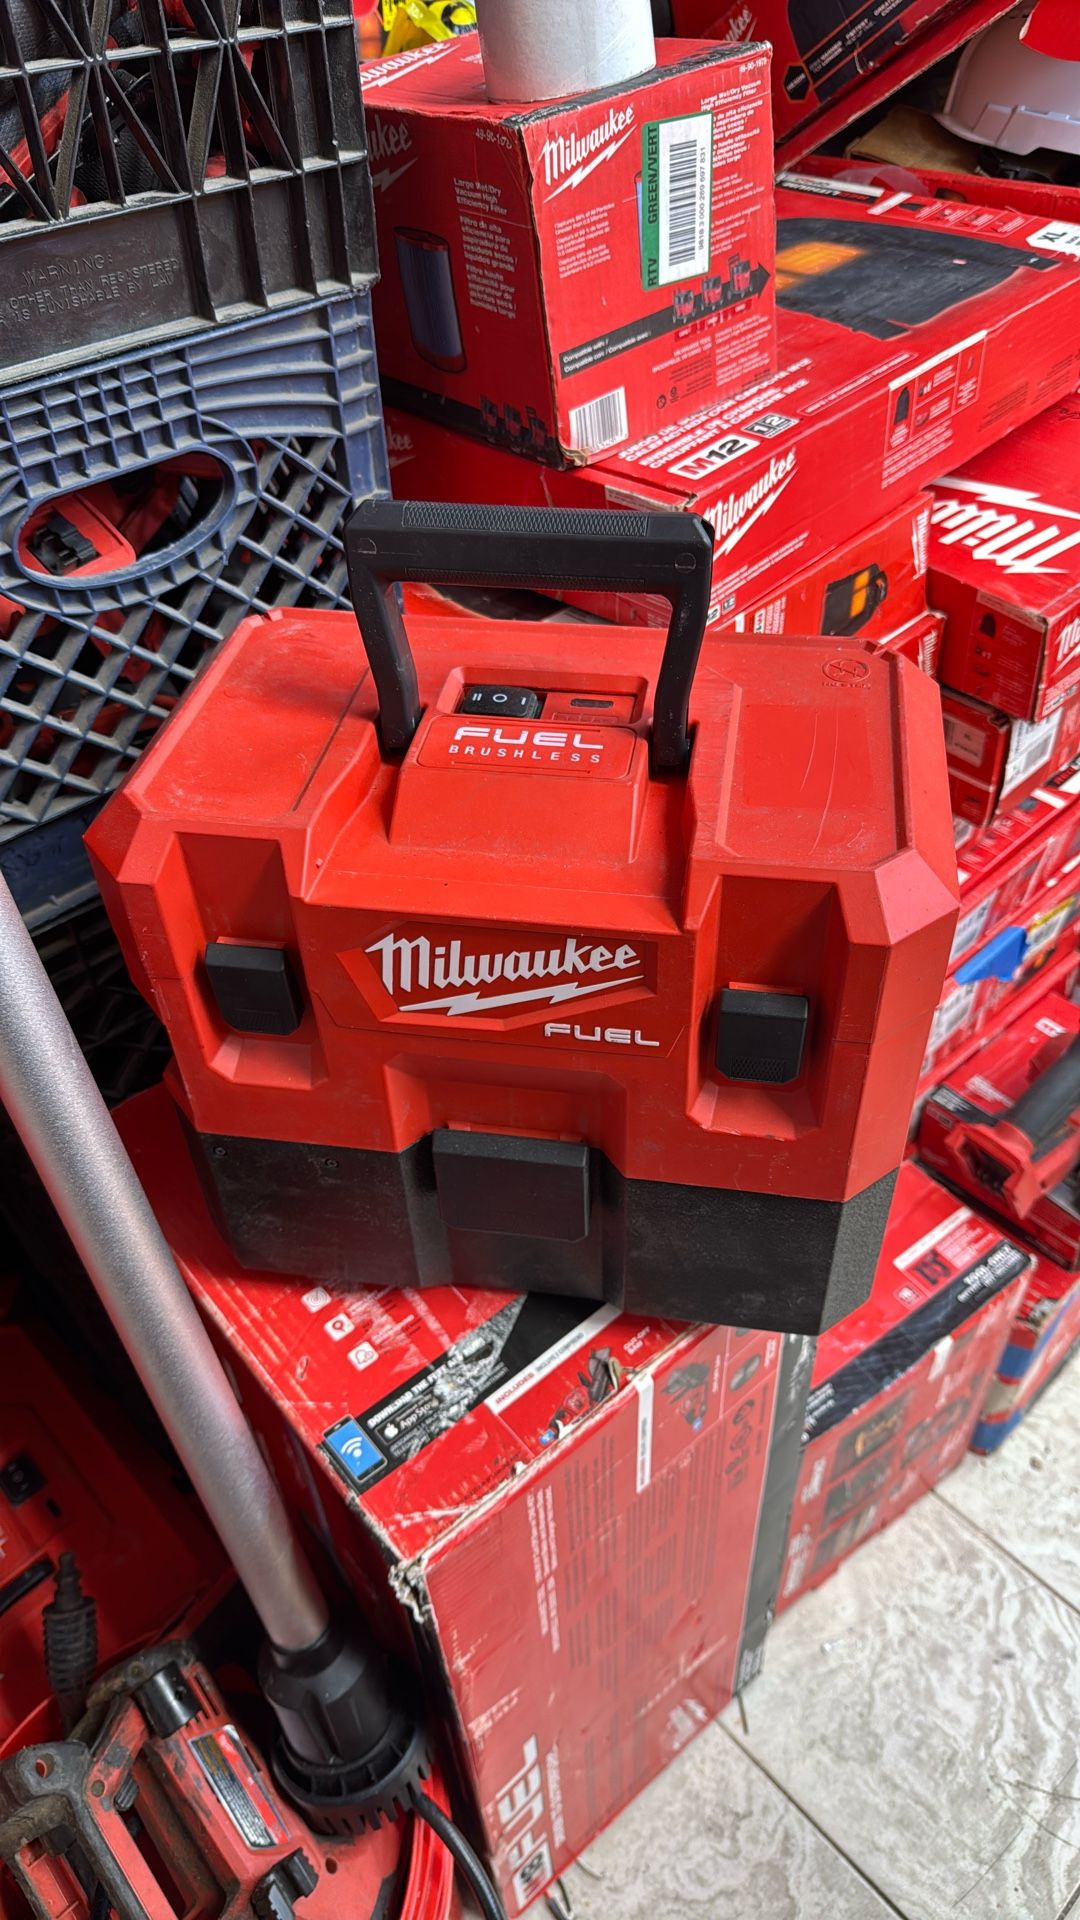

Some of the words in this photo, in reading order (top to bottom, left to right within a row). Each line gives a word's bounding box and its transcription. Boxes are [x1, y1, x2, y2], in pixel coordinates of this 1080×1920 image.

[537, 104, 636, 187] Milwaukee
[647, 126, 658, 224] GREEN/VERT
[9, 289, 51, 310] OTHER
[100, 257, 178, 286] REGISTERED
[647, 258, 658, 287] RTV
[617, 435, 660, 460] JUEGO
[678, 438, 749, 476] M12
[703, 447, 796, 542] Milwaukee
[453, 726, 604, 750] FUEL
[448, 744, 601, 764] BRUSHLESS
[364, 932, 641, 996] Milwaukee
[544, 1023, 660, 1047] FUEL
[411, 1377, 430, 1395] THE
[495, 1372, 535, 1405] INCLUDES
[399, 1412, 419, 1431] App
